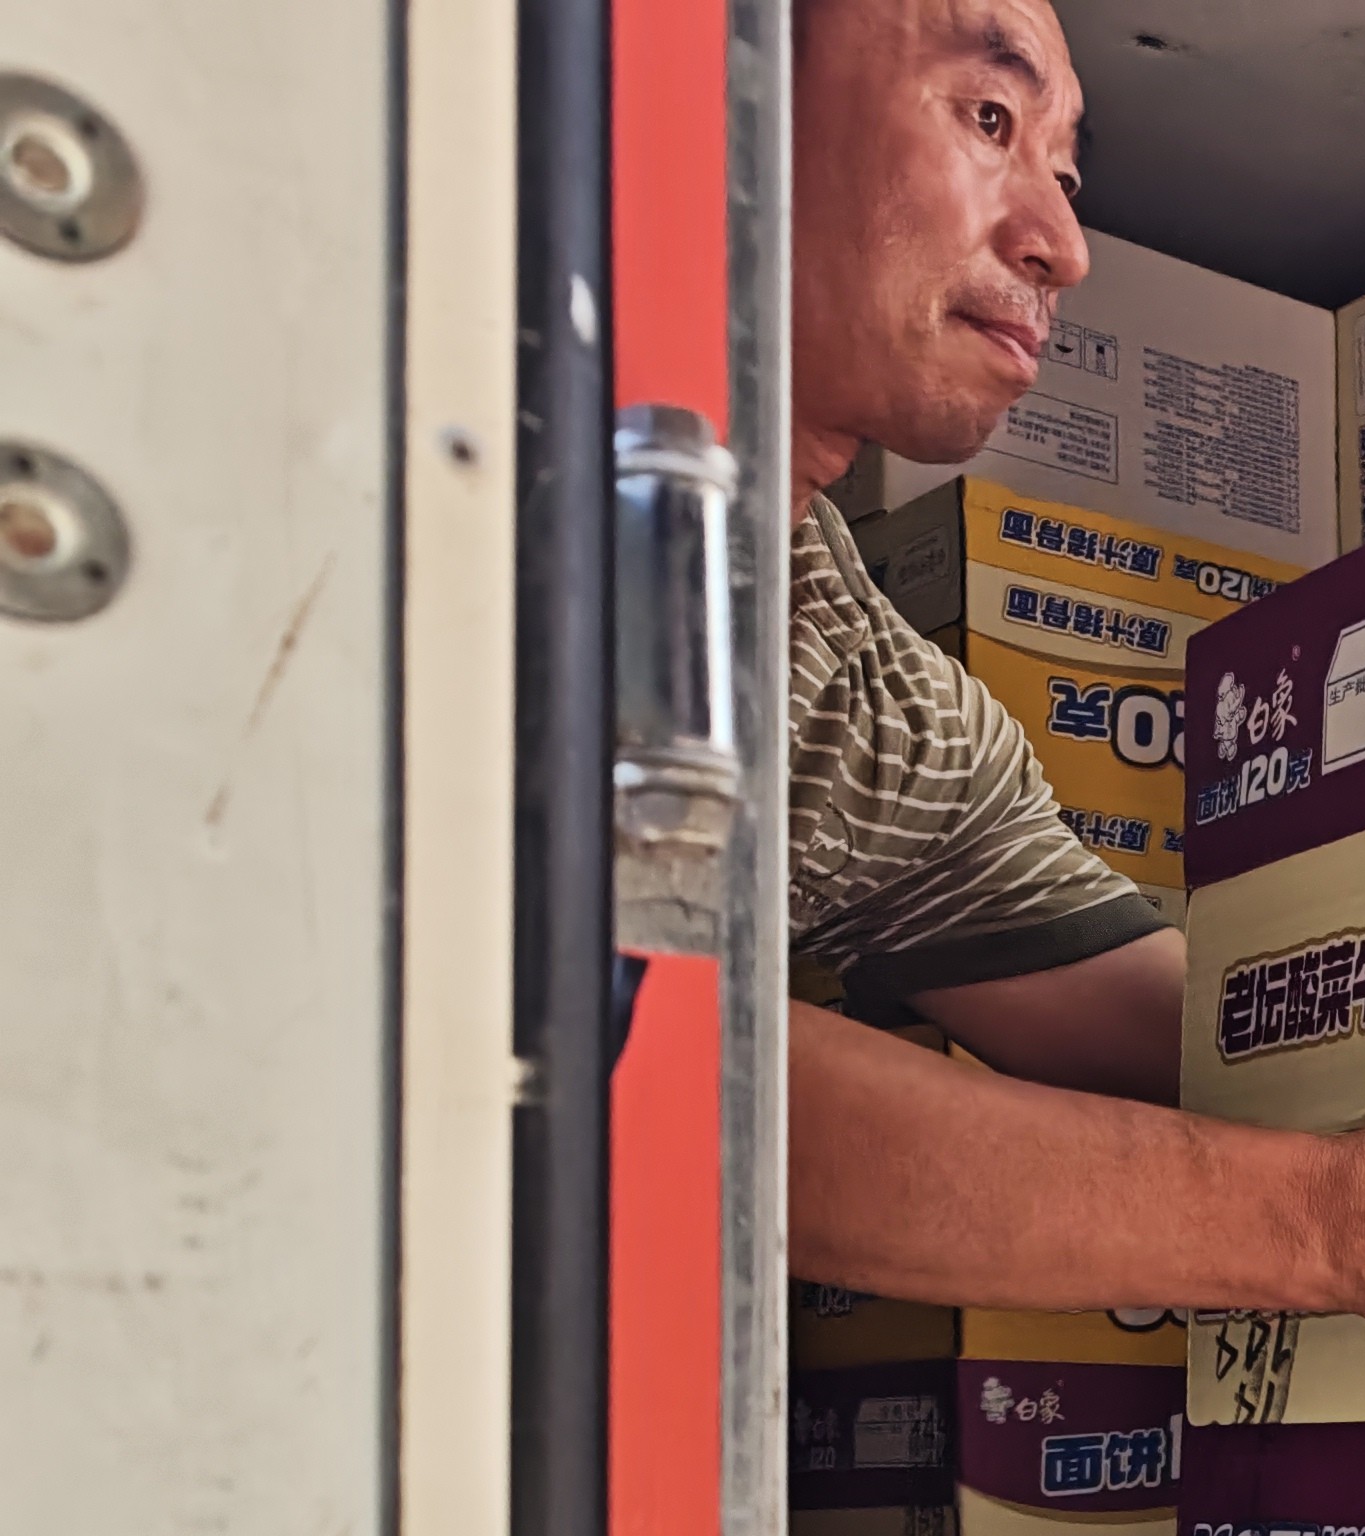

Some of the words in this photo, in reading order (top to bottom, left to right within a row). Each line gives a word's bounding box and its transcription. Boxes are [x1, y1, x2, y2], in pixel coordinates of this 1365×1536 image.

[1000, 507, 1163, 580] 原汁猪骨面
[1002, 583, 1173, 657] 原汁猪骨面
[1247, 668, 1299, 746] 白象
[1195, 745, 1313, 826] 面饼120克
[1014, 1387, 1066, 1425] 白象
